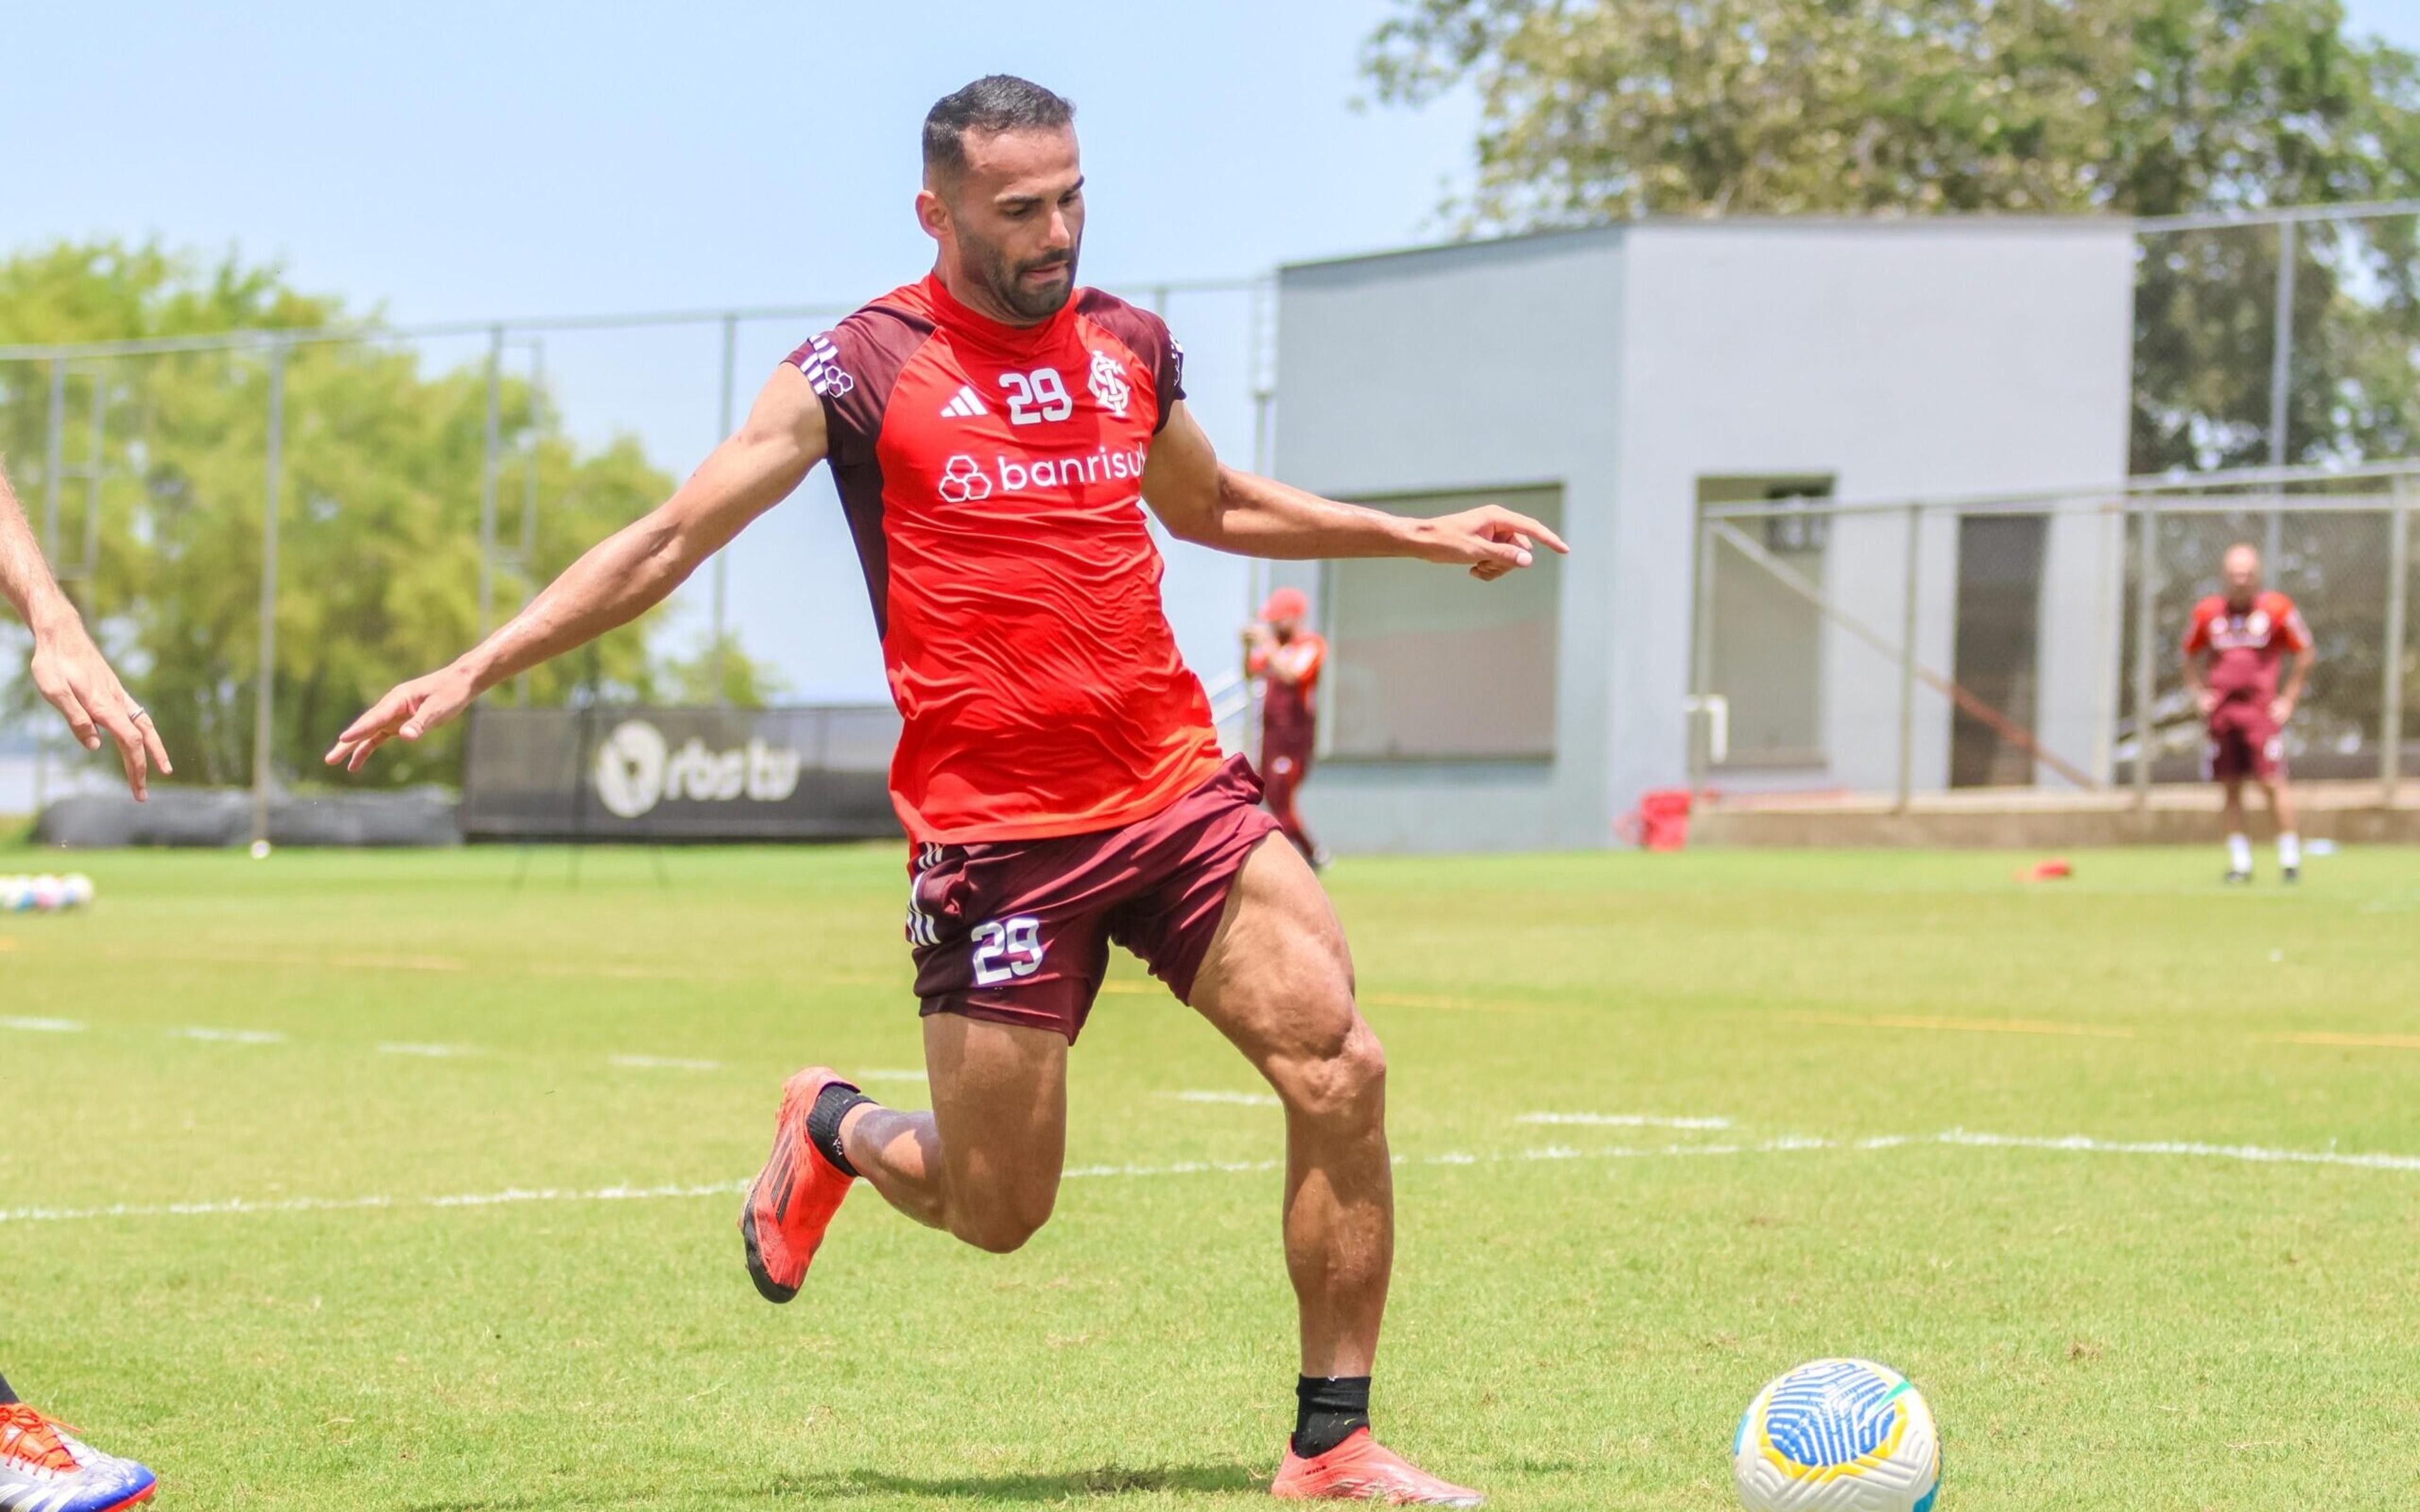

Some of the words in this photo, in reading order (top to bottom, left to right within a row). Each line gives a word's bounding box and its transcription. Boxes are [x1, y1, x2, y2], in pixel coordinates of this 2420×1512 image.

[999, 368, 1073, 425] 29
[998, 441, 1145, 491] banrisul
[665, 736, 743, 800] rbs
[971, 918, 1043, 985] 29
